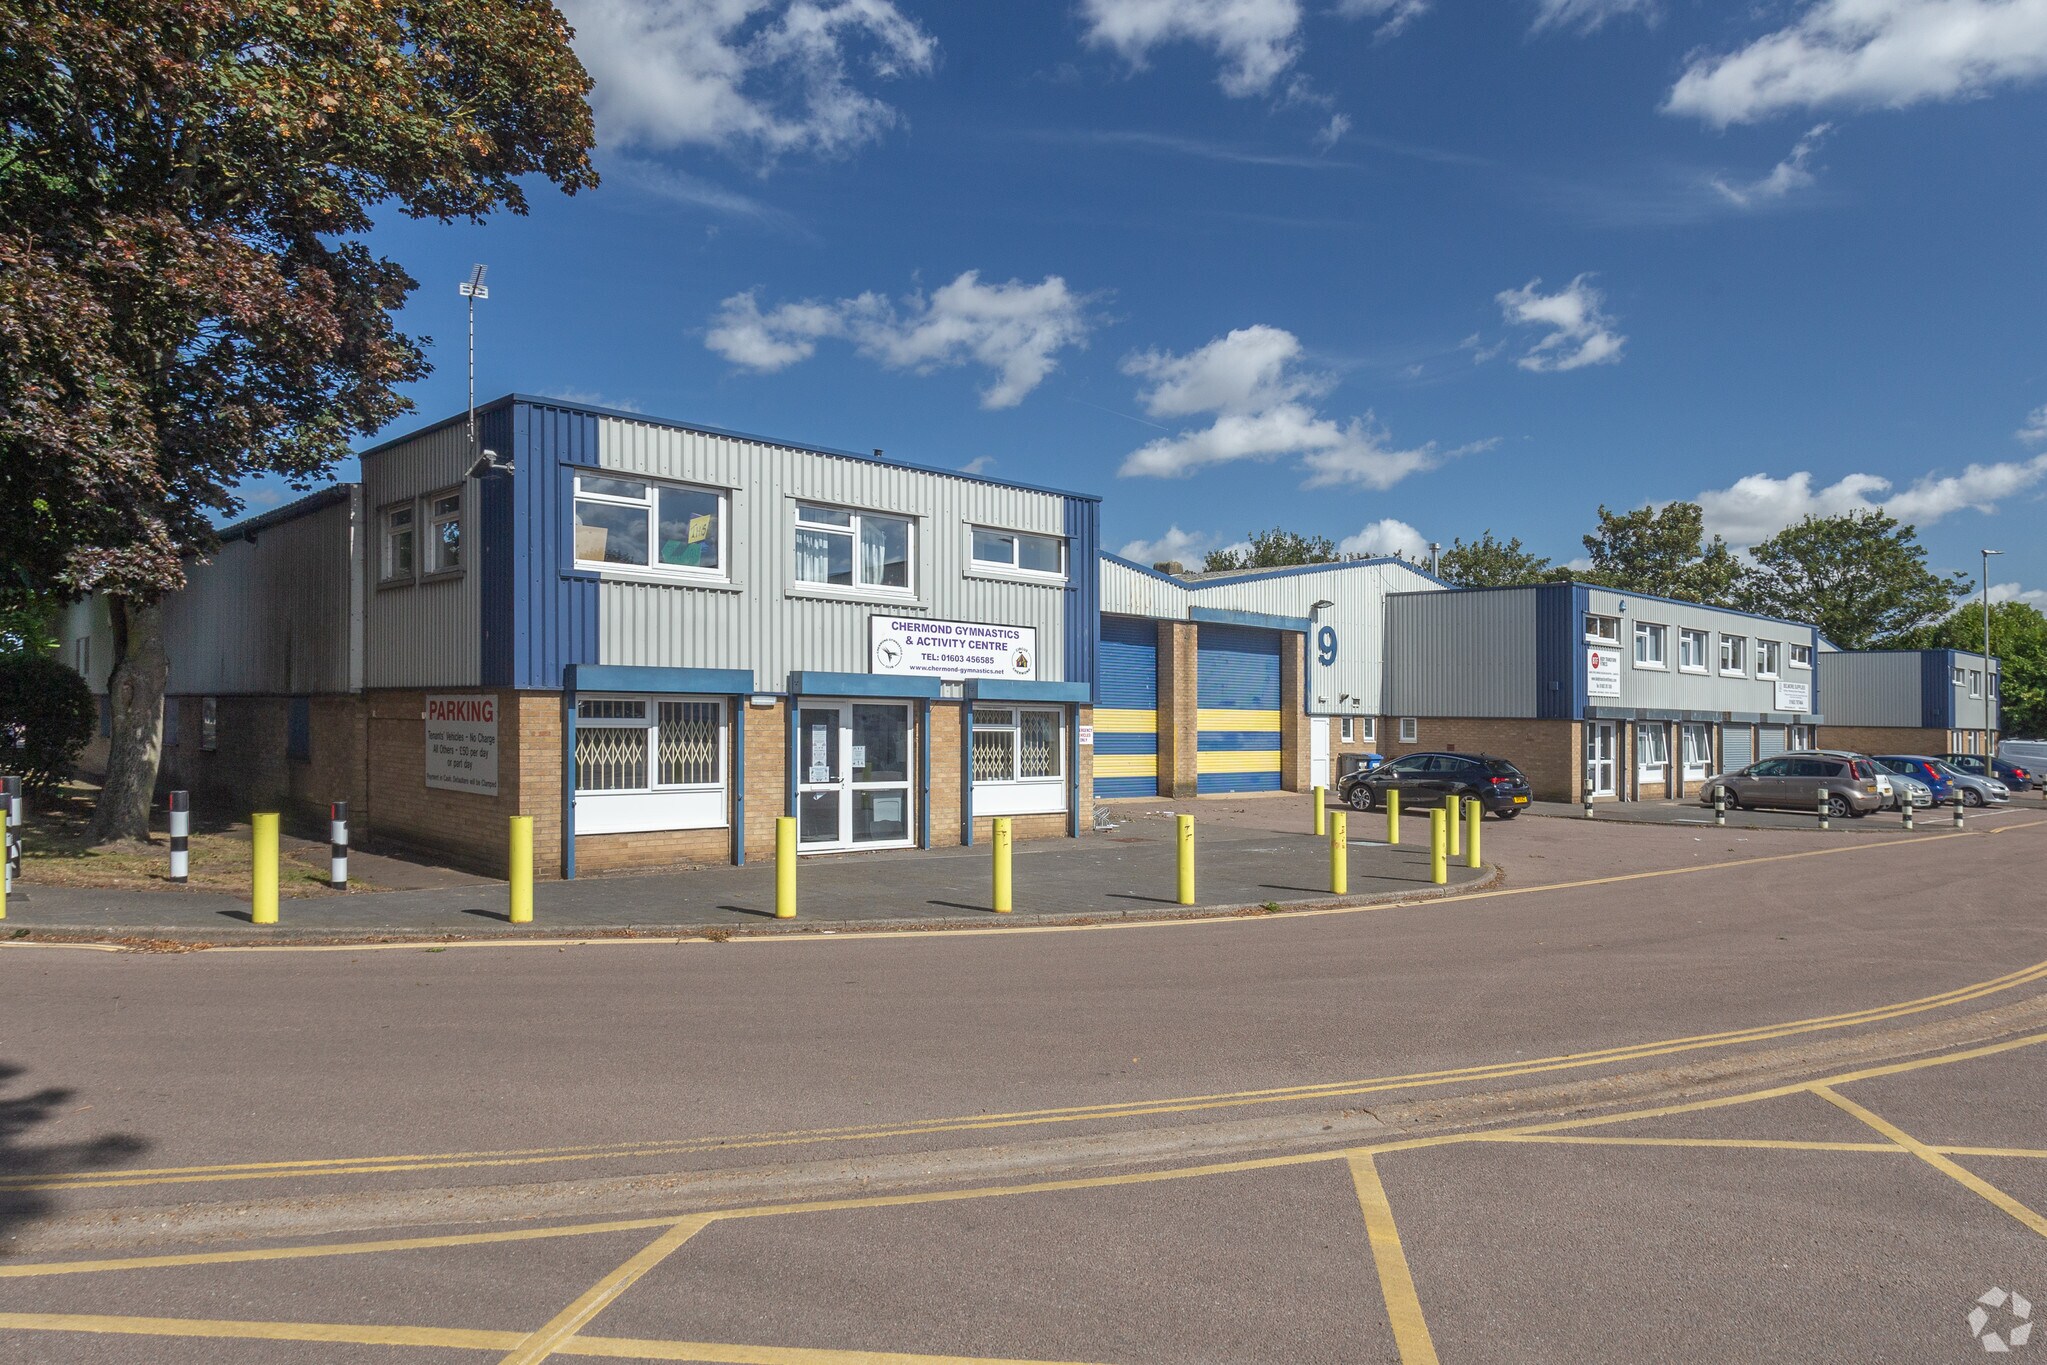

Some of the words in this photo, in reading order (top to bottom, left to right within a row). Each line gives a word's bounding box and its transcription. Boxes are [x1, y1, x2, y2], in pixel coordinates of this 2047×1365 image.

[891, 621, 953, 634] CHERMOND
[955, 626, 1020, 639] GYMNASTICS
[905, 636, 914, 645] &
[916, 636, 966, 649] ACTIVITY
[968, 640, 1008, 651] CENTRE
[1317, 625, 1338, 667] 9
[921, 653, 940, 661] TEL:
[941, 654, 964, 663] 01603
[965, 655, 995, 665] 456585
[909, 664, 1005, 675] www.chermond-gymnastics.net
[429, 700, 494, 723] PARKING
[469, 733, 477, 743] No
[477, 733, 496, 746] Charge
[439, 744, 454, 755] Others
[459, 746, 470, 756] £50
[470, 749, 479, 759] per
[479, 747, 489, 760] day
[447, 759, 453, 767] or
[453, 759, 463, 769] part
[464, 759, 473, 771] day
